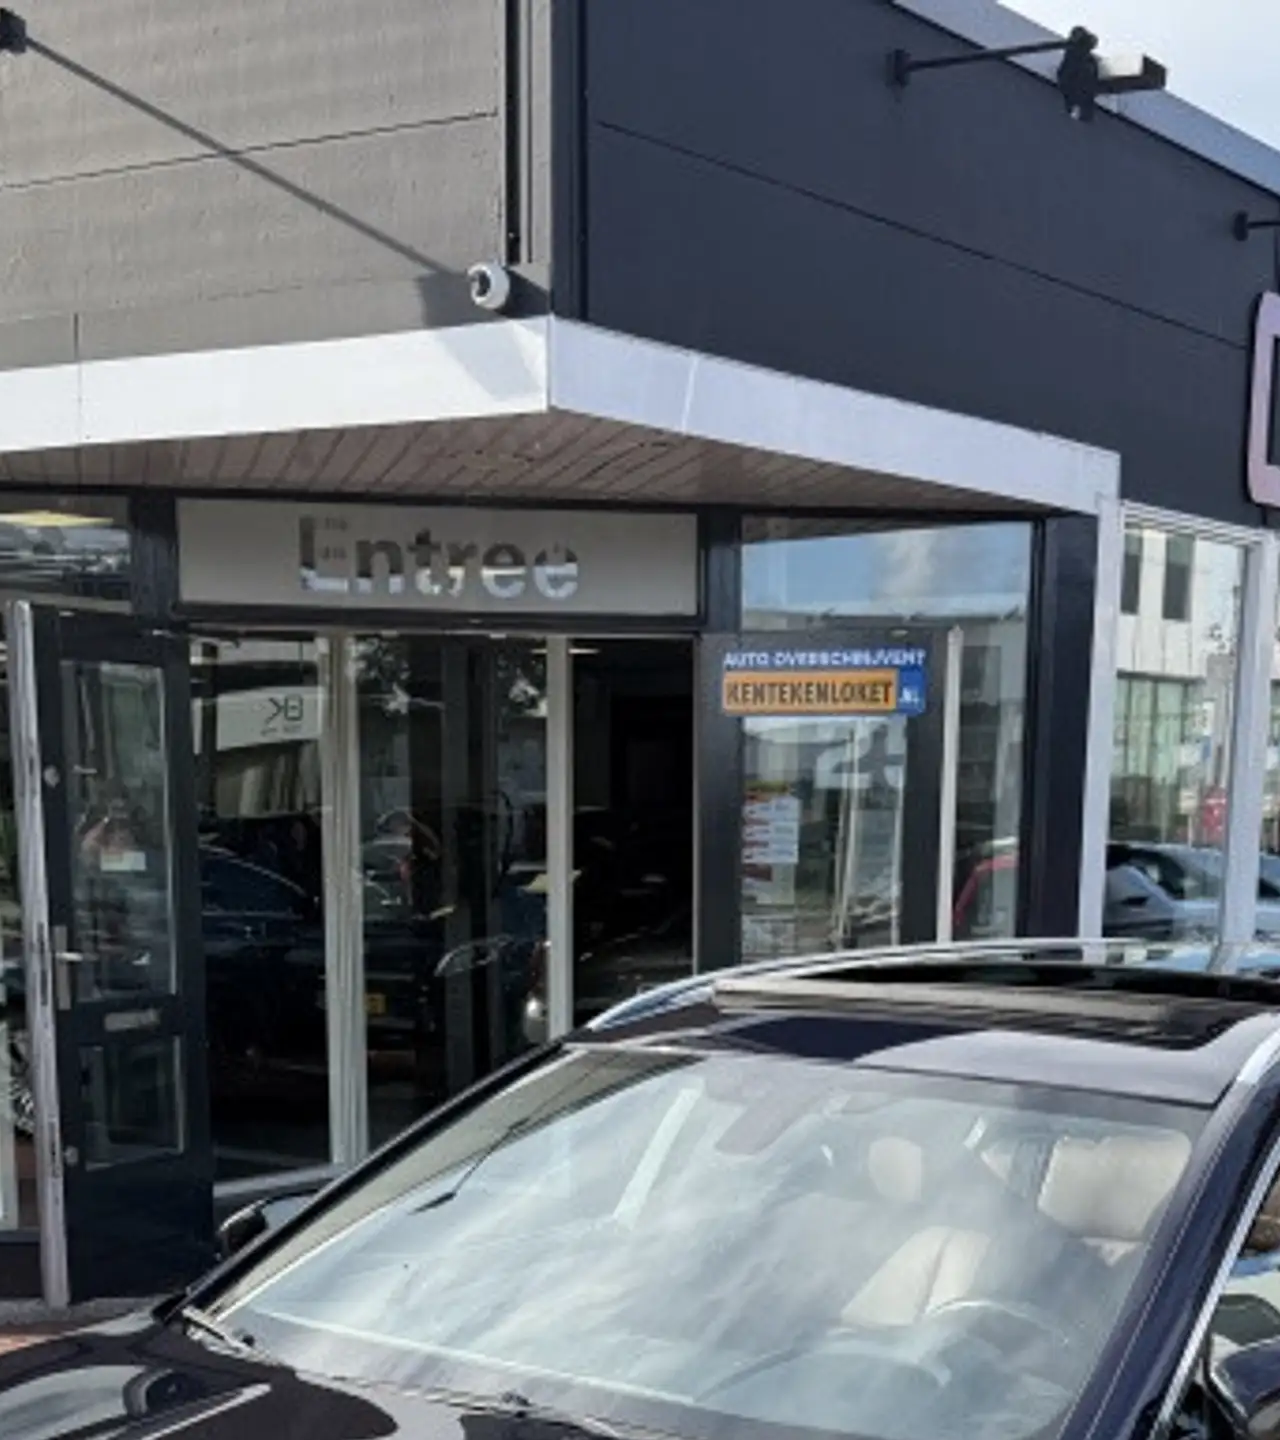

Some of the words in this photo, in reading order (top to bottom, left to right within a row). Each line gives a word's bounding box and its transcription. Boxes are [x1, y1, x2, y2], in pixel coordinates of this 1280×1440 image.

[299, 515, 578, 599] Entree
[723, 651, 770, 668] AUTO
[725, 680, 893, 706] KENTEKENLOKET
